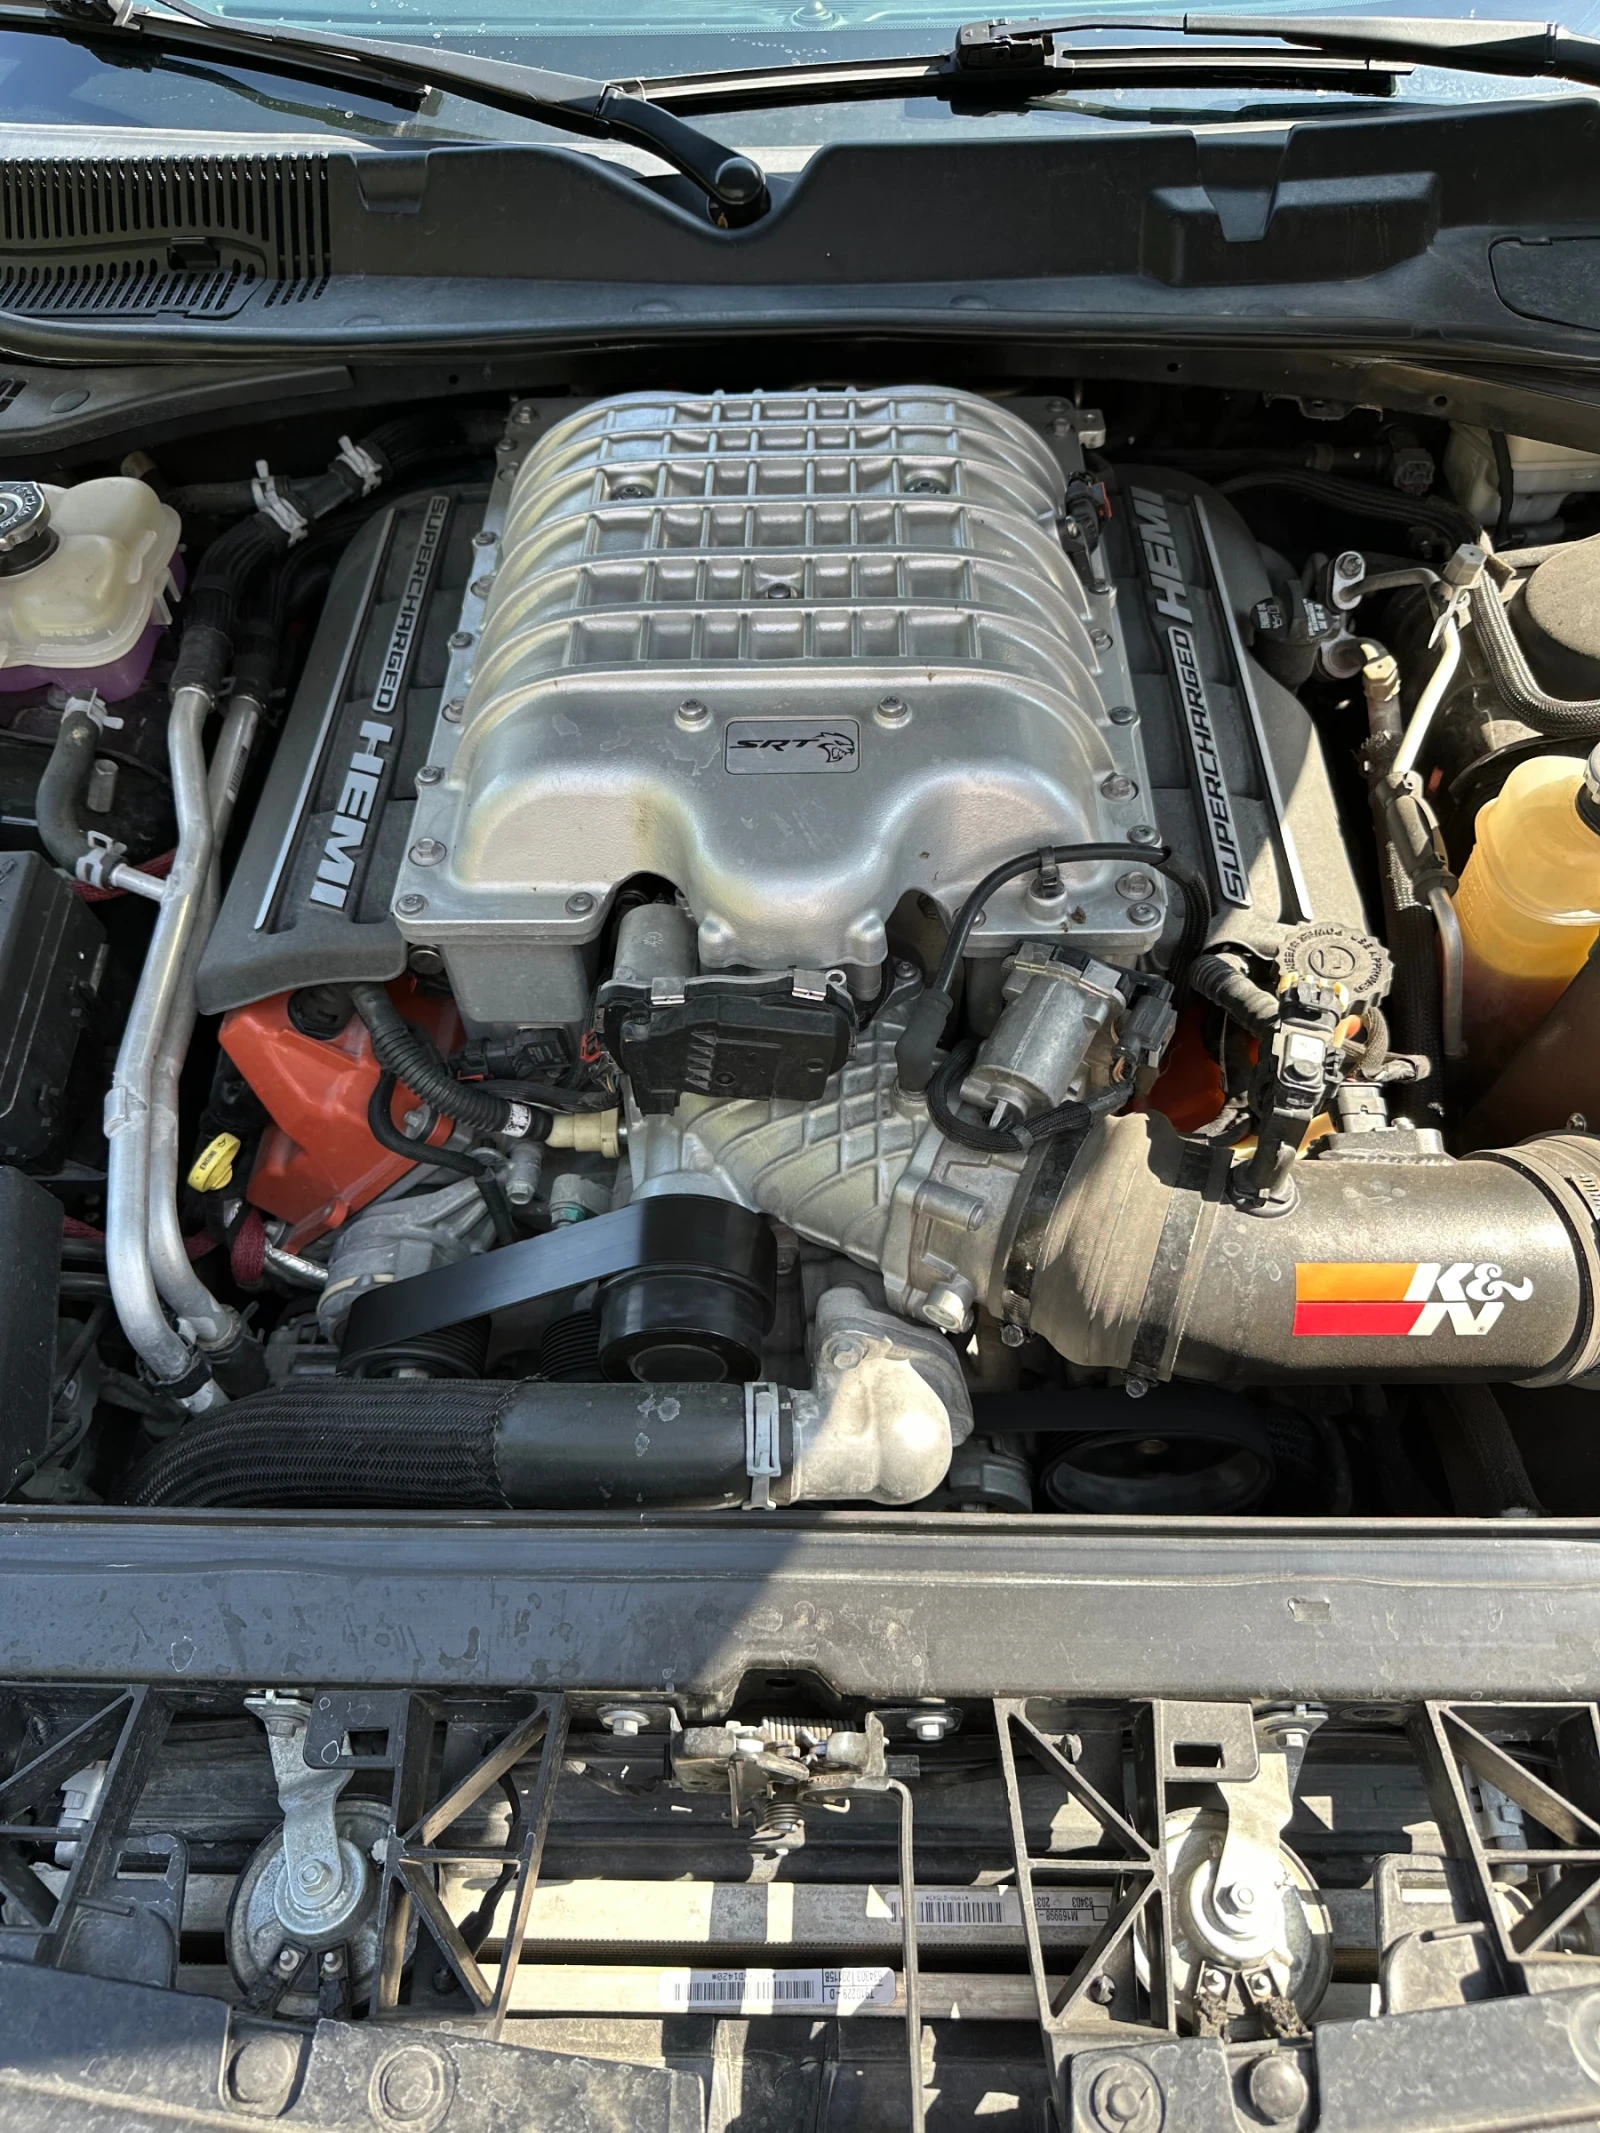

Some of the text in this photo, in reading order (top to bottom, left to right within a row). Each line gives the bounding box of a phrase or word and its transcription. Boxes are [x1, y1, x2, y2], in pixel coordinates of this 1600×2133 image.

[310, 498, 447, 908] SUPERCHARGED HEMI
[729, 739, 819, 752] SRT
[1130, 485, 1247, 902] SUPERCHARGED HEMI
[199, 1150, 217, 1171] ENGINE
